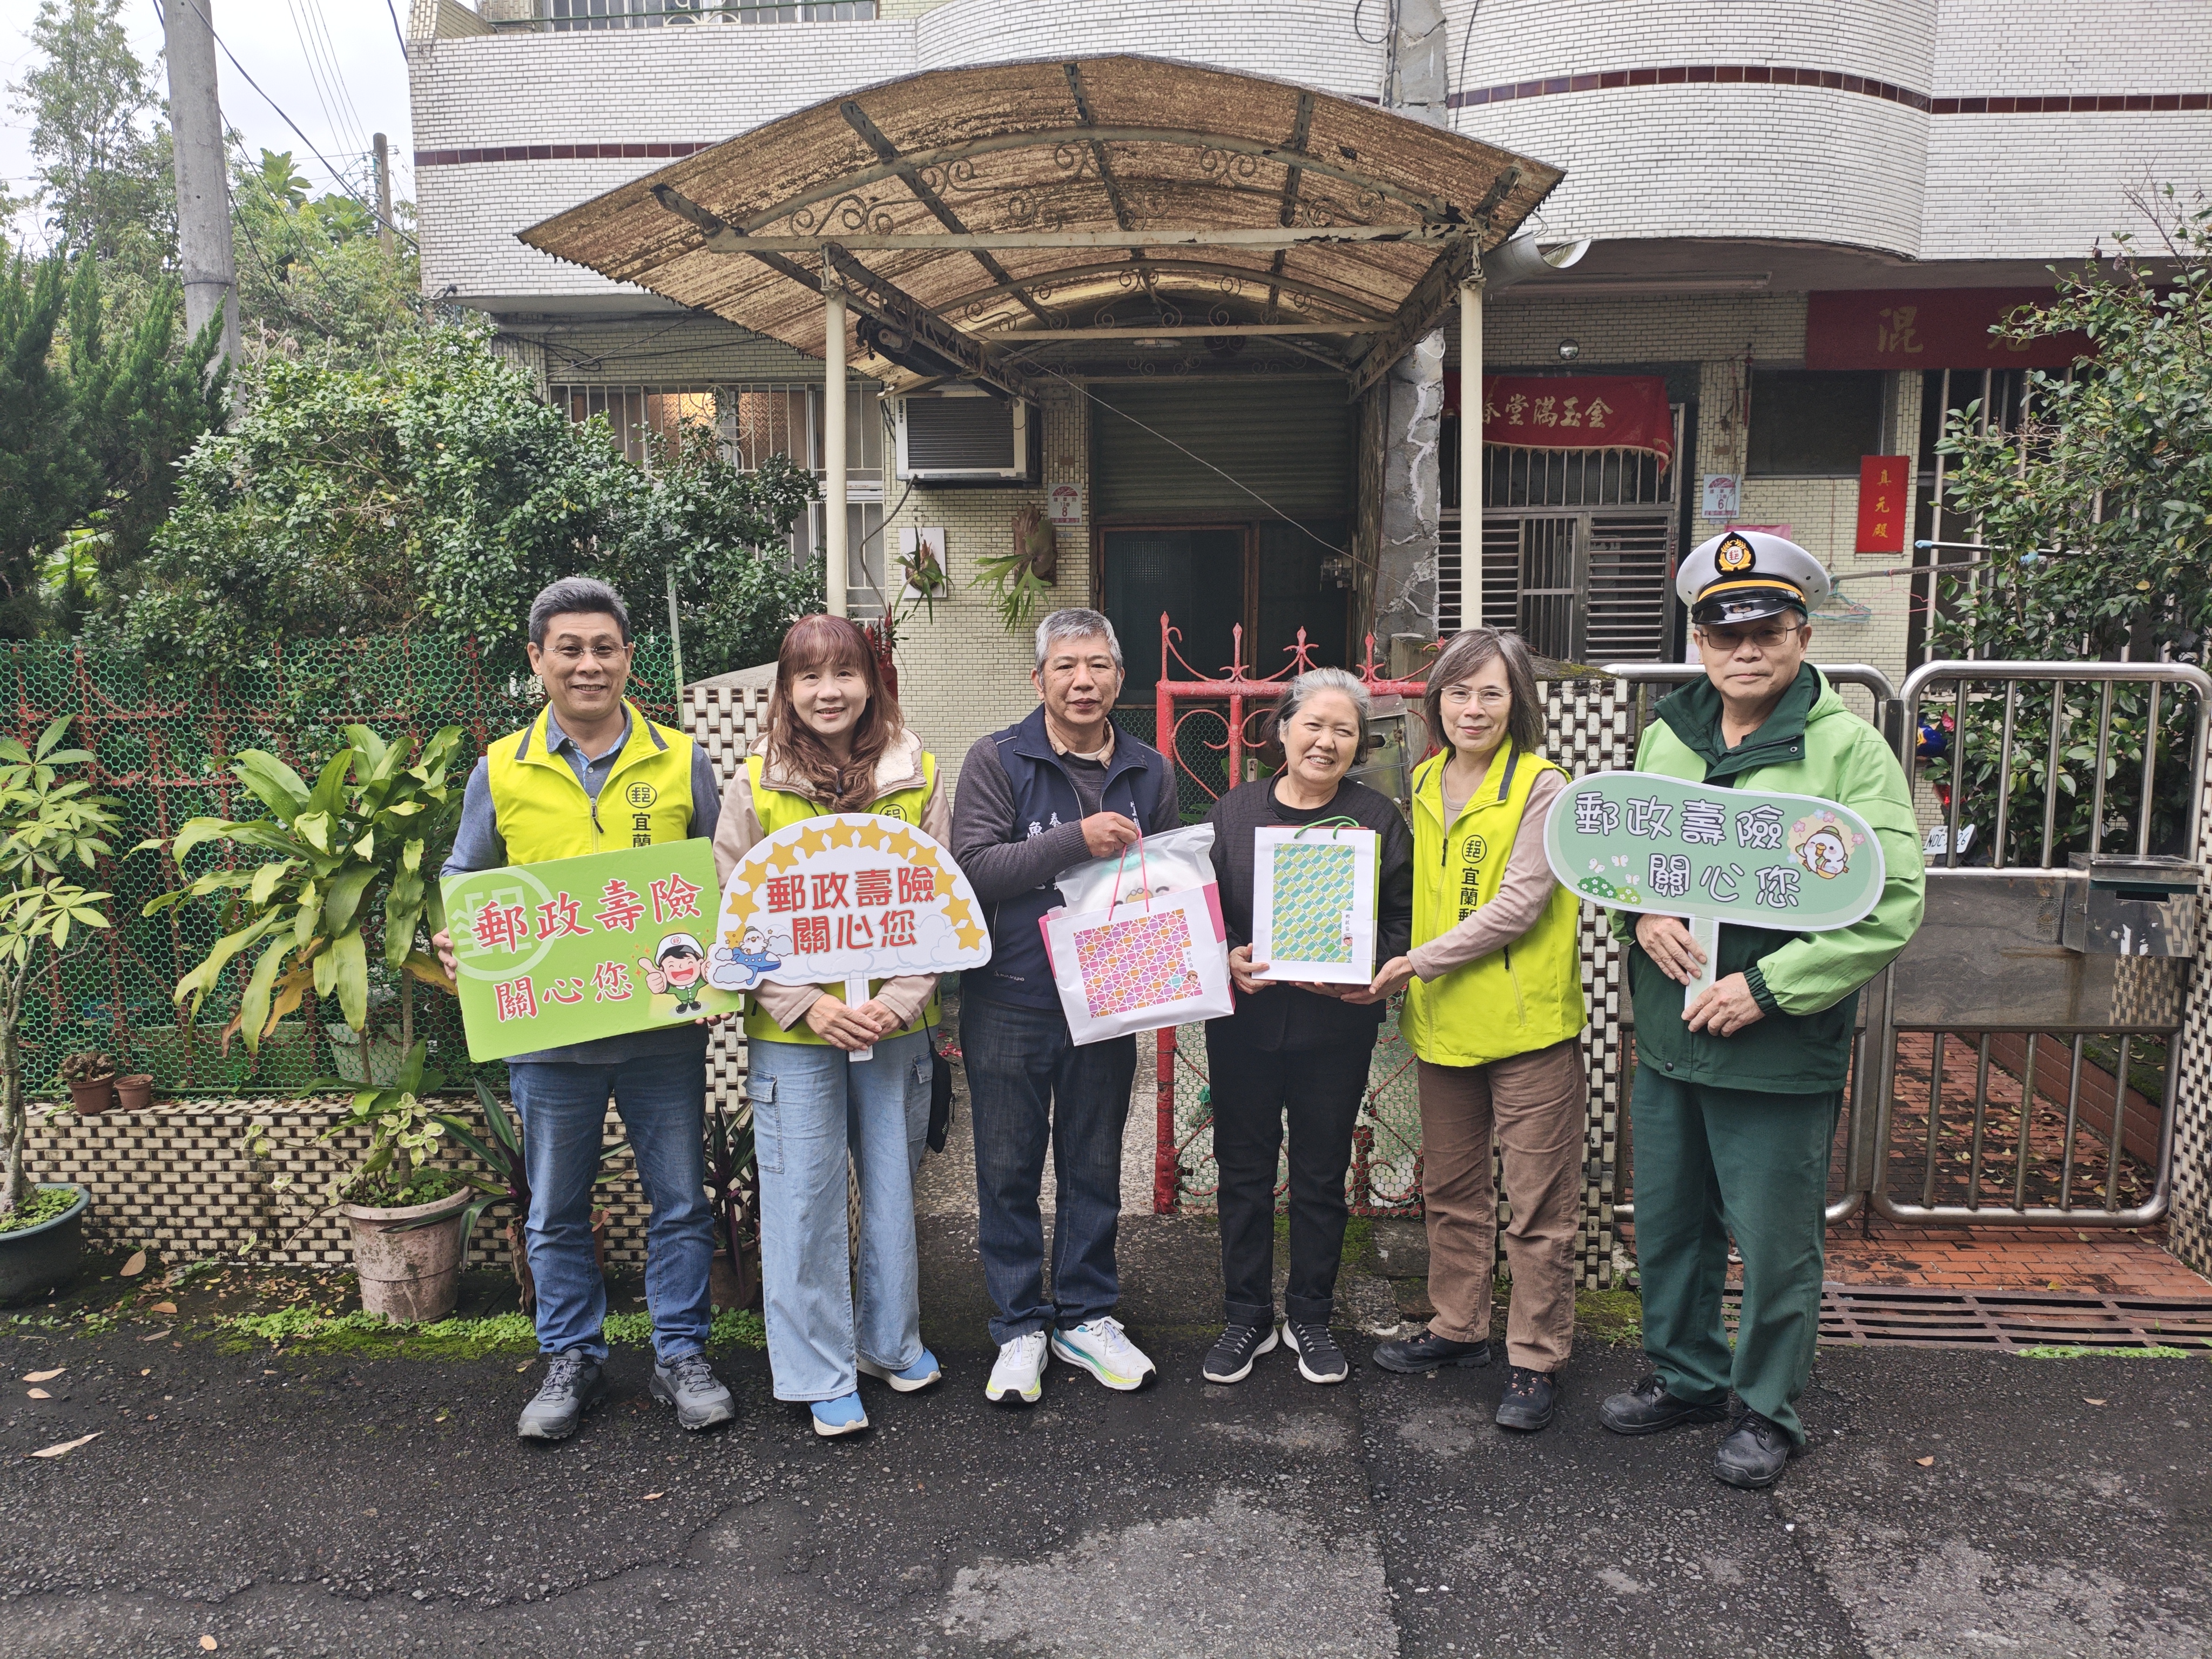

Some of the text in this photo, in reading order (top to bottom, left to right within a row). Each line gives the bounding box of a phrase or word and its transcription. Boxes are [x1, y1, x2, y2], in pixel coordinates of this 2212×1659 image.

[1062, 507, 1068, 517] 8
[1718, 499, 1724, 510] 6
[1872, 469, 1892, 538] 真元殿
[631, 787, 651, 803] 郵
[1575, 791, 1785, 850] 郵政壽險
[1465, 840, 1482, 859] 郵
[766, 865, 936, 914] 郵政壽險
[1648, 853, 1801, 909] 關心您
[471, 872, 704, 953] 郵政壽險
[791, 909, 918, 956] 關心您
[493, 960, 635, 1023] 關心您
